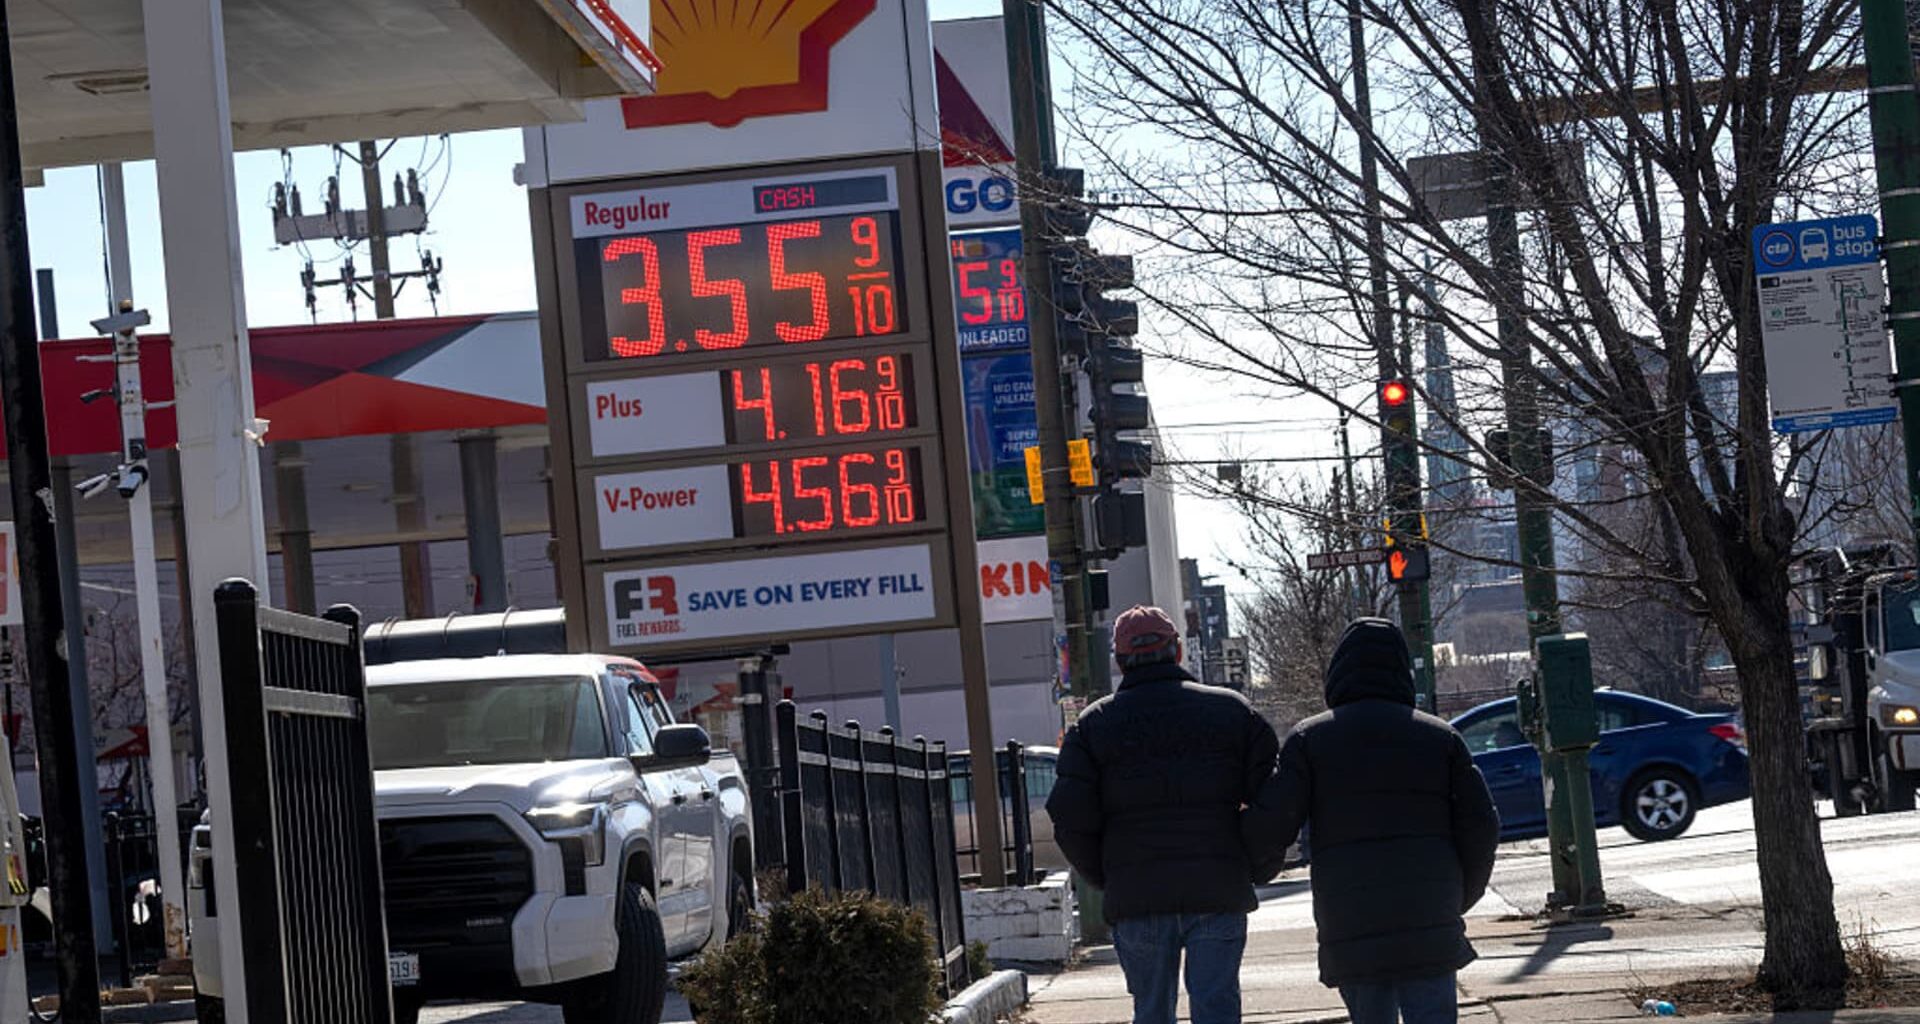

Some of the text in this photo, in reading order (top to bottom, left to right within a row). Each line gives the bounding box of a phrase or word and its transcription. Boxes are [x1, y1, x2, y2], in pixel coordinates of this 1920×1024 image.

[584, 195, 671, 230] Regular
[758, 187, 816, 211] CASH
[1833, 225, 1866, 240] bus
[1766, 242, 1790, 255] cta
[1835, 241, 1875, 258] stop
[603, 220, 830, 358] 3.55
[596, 392, 643, 420] Plus
[732, 359, 871, 441] 4.16
[603, 486, 699, 513] V-Power
[741, 453, 880, 534] 4.56
[688, 573, 924, 612] SAVE ON EVERY FILL
[616, 622, 637, 638] FUEL
